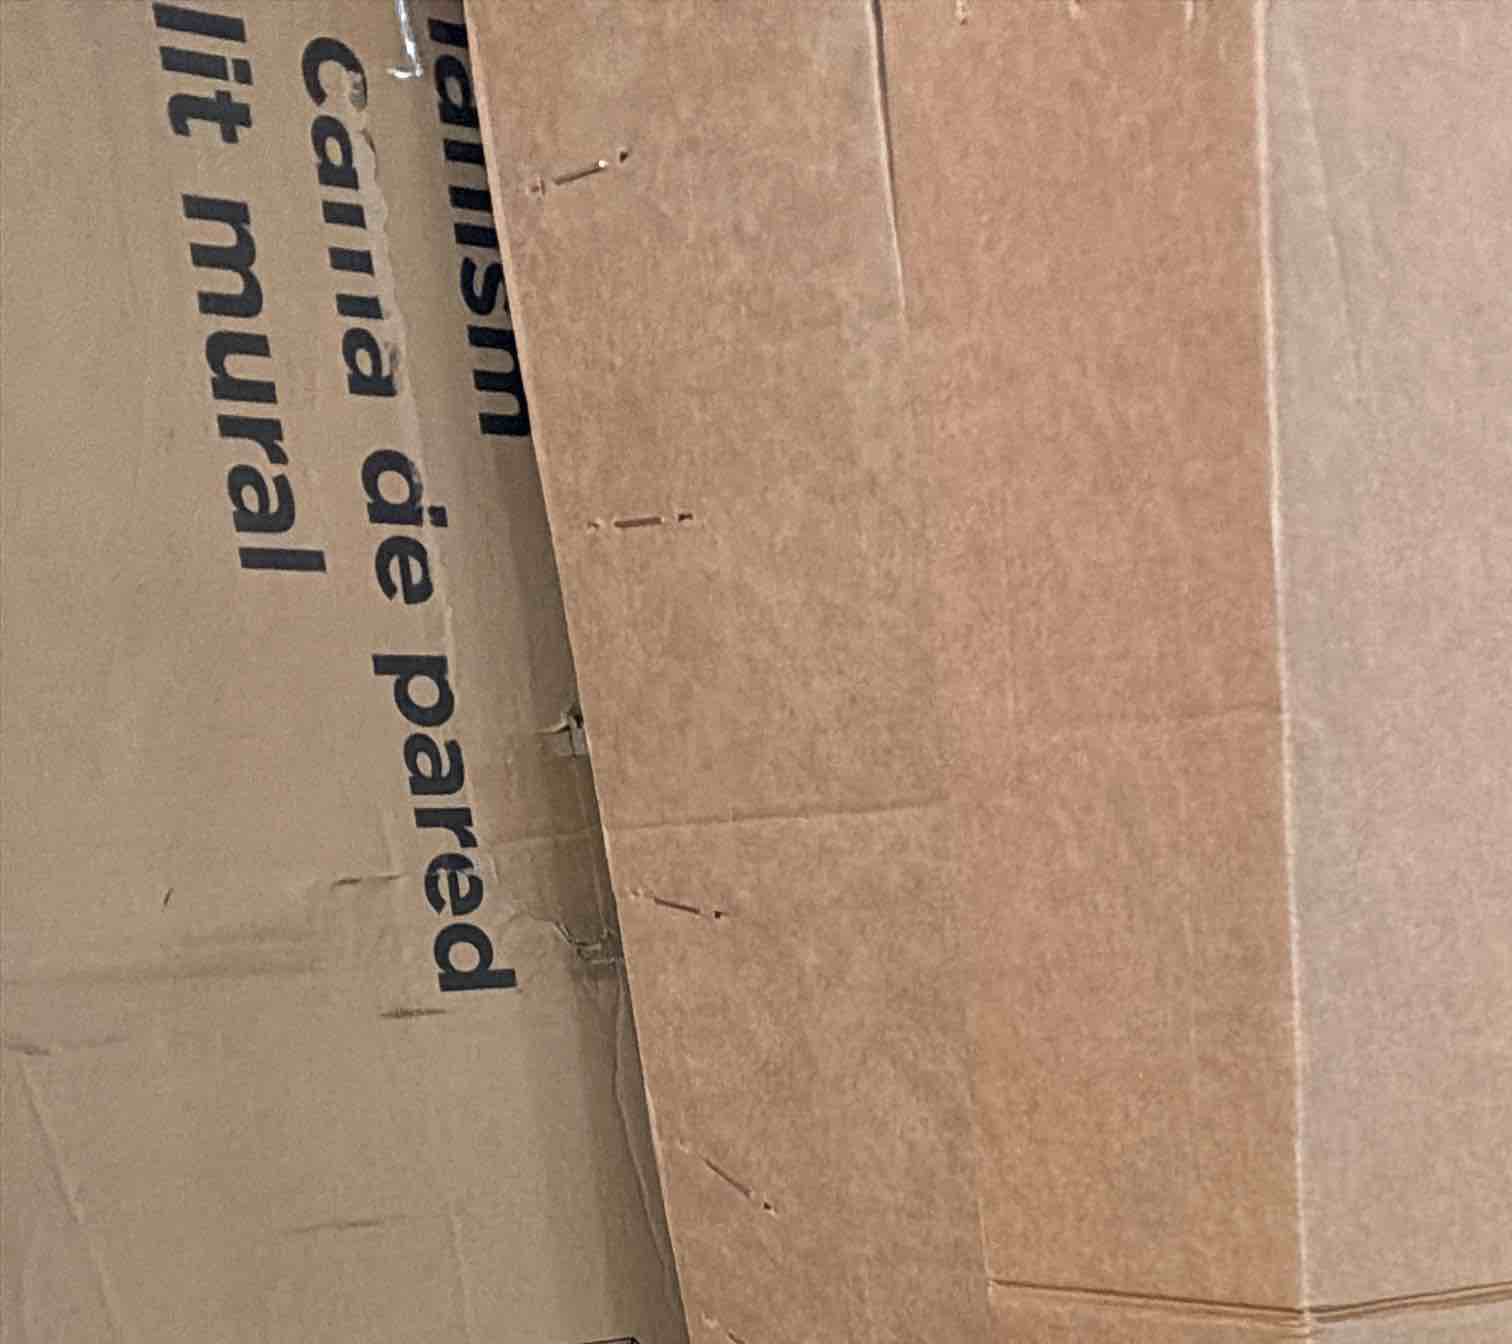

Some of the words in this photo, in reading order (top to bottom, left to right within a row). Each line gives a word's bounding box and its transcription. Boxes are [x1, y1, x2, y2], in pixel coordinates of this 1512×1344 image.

[182, 193, 328, 573] mural
[359, 448, 449, 606] de
[372, 652, 522, 993] pared
